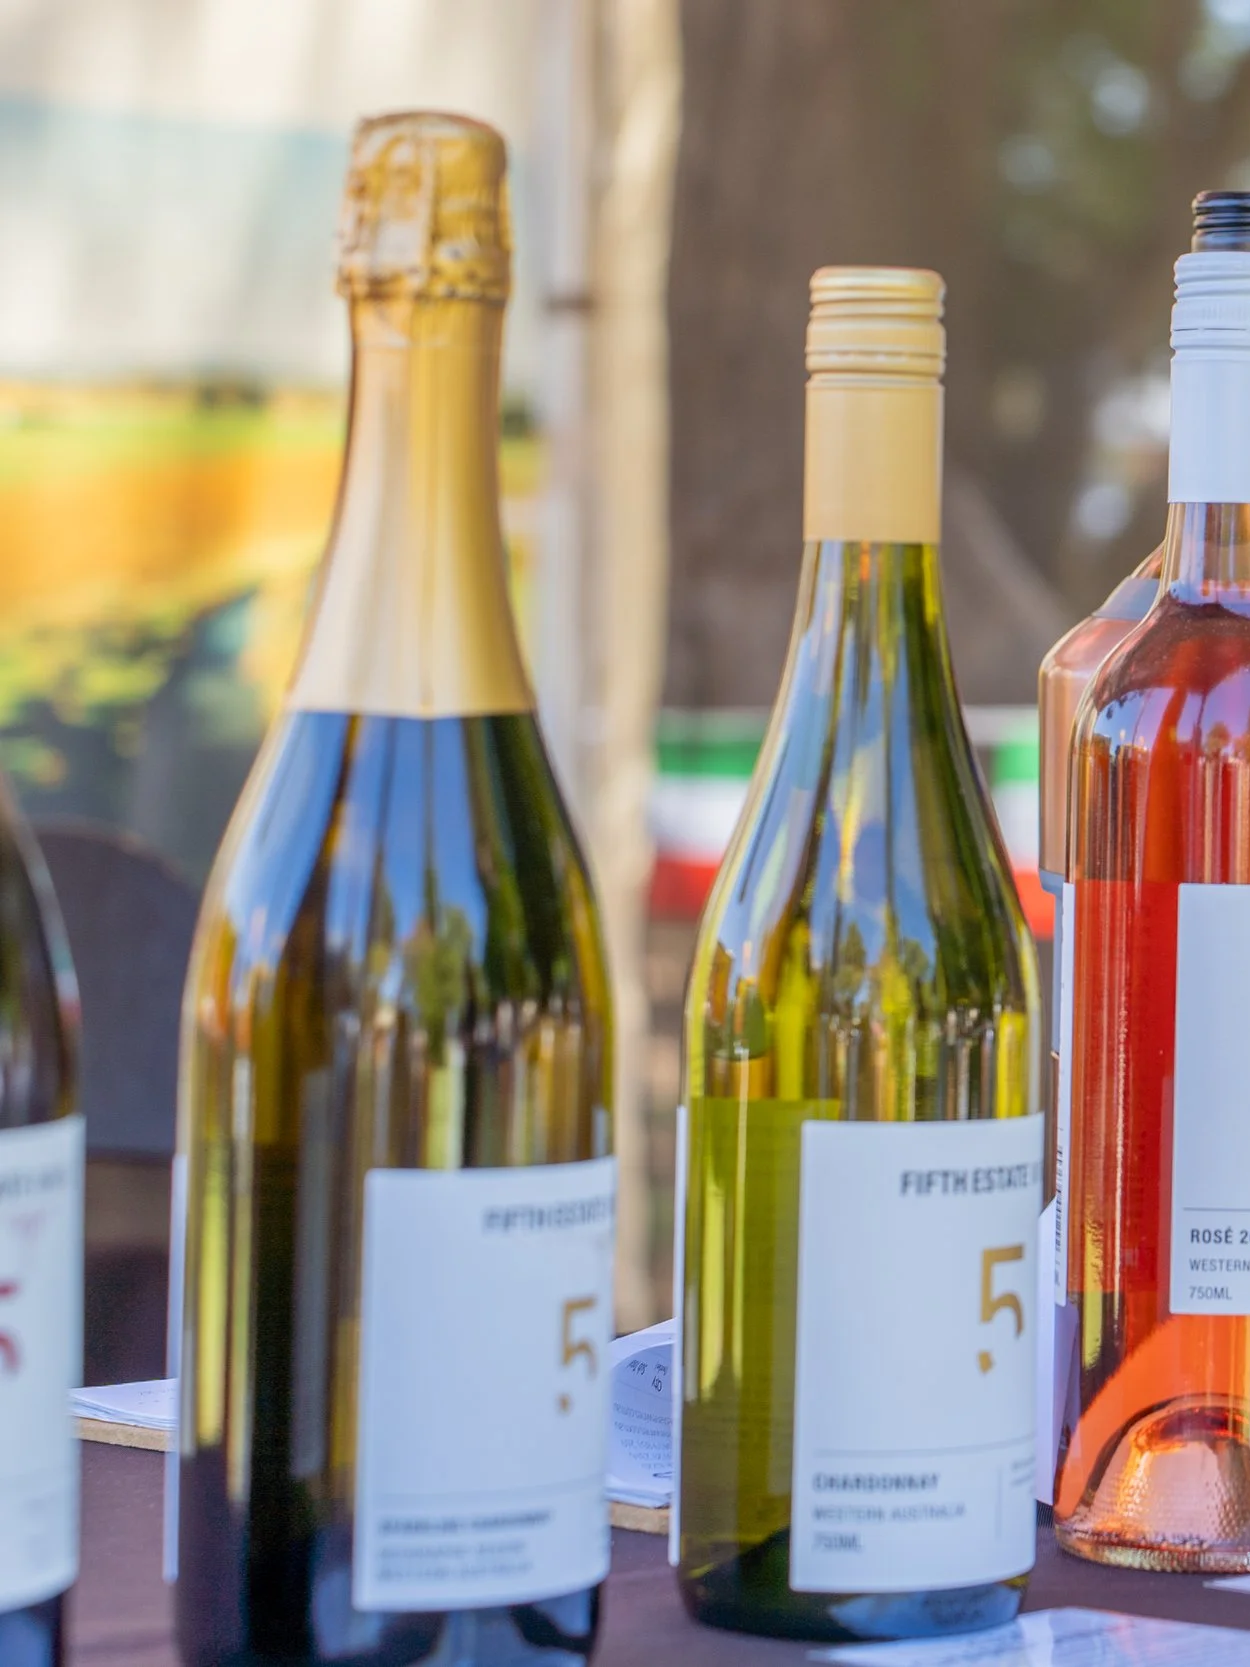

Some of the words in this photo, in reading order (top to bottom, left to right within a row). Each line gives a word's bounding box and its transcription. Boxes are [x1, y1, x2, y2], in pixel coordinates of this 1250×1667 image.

[900, 1169, 968, 1196] FIFTH
[971, 1163, 1028, 1193] ESTATE
[1190, 1227, 1233, 1244] ROSÉ
[1189, 1259, 1250, 1272] WESTERN
[1189, 1286, 1232, 1300] 750ML
[977, 1244, 1024, 1374] 5
[813, 1472, 940, 1493] CHARDONNAY
